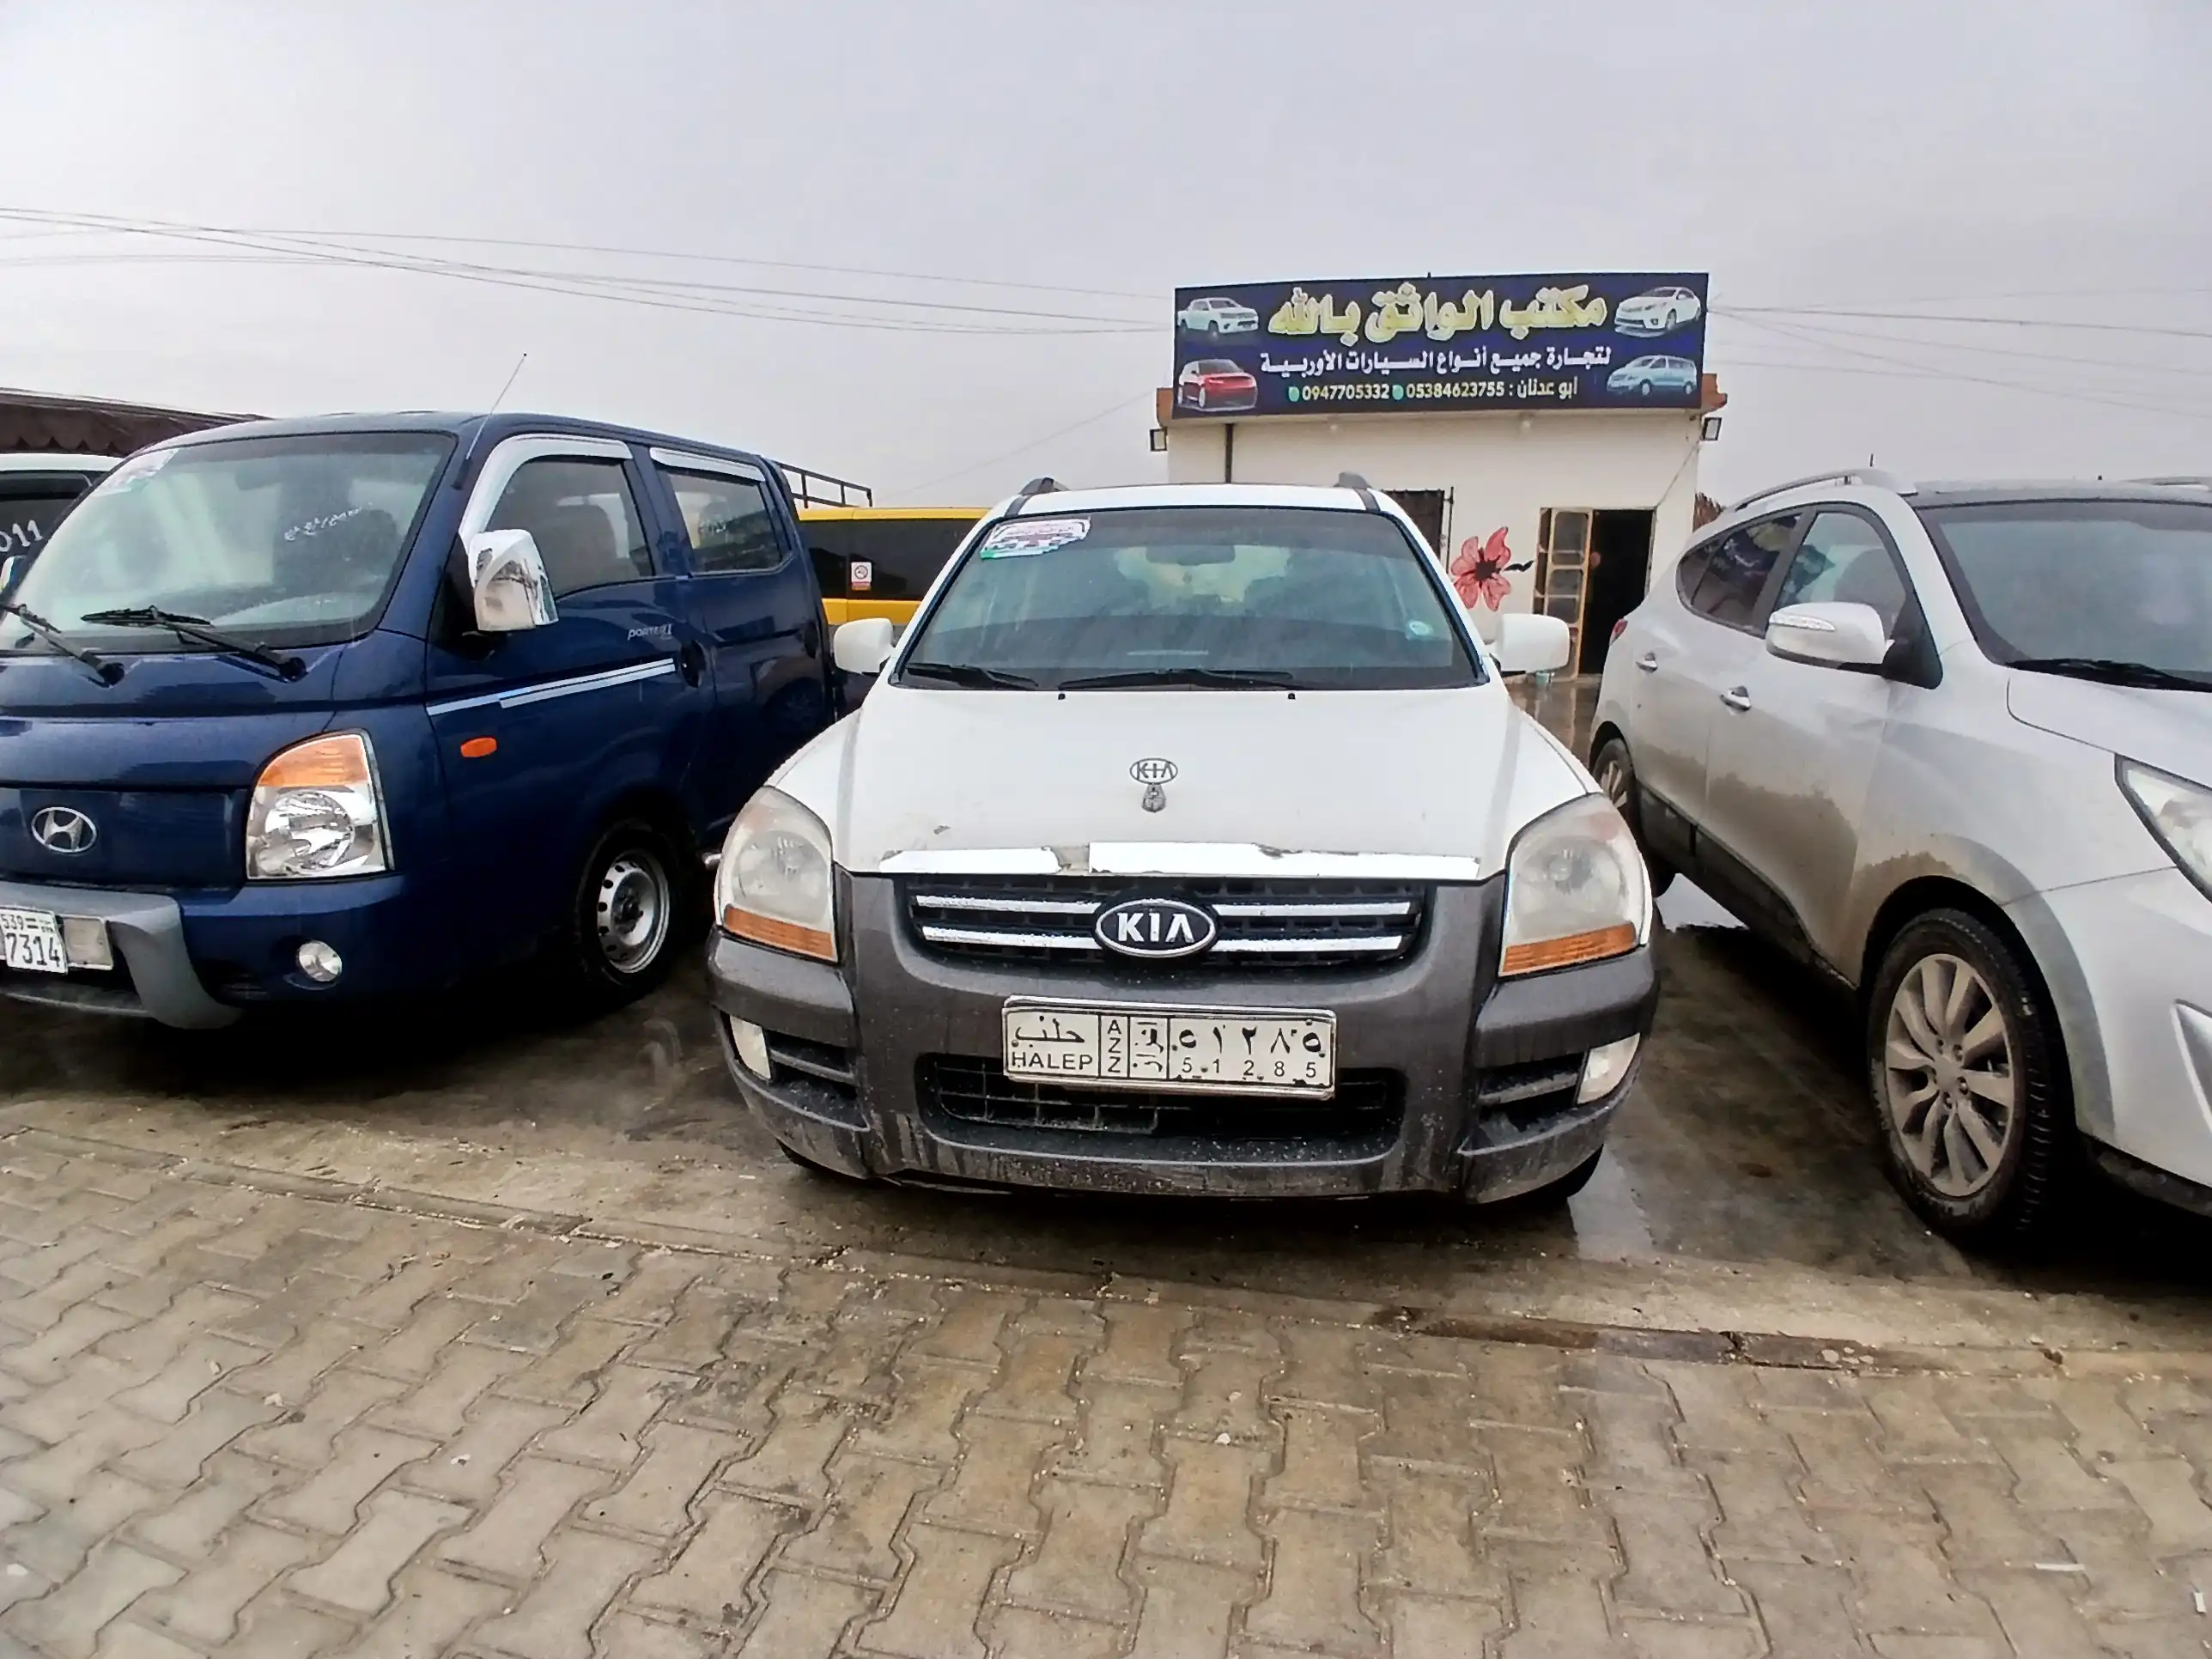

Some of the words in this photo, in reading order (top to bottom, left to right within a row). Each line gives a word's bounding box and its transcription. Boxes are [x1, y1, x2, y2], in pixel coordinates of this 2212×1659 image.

[1268, 287, 1362, 347] بالله
[1364, 282, 1494, 343] الواثق
[1499, 284, 1607, 340] مكتب
[1346, 349, 1434, 375] السيارات
[1437, 345, 1487, 374] أنواع
[1490, 349, 1542, 374] جميع
[1547, 345, 1613, 370] لتجارة
[1302, 383, 1390, 401] 0947705332
[1406, 380, 1505, 399] 05384623755
[1117, 912, 1194, 943] KIA
[5, 933, 61, 968] 7314
[1012, 1051, 1093, 1071] HALEP
